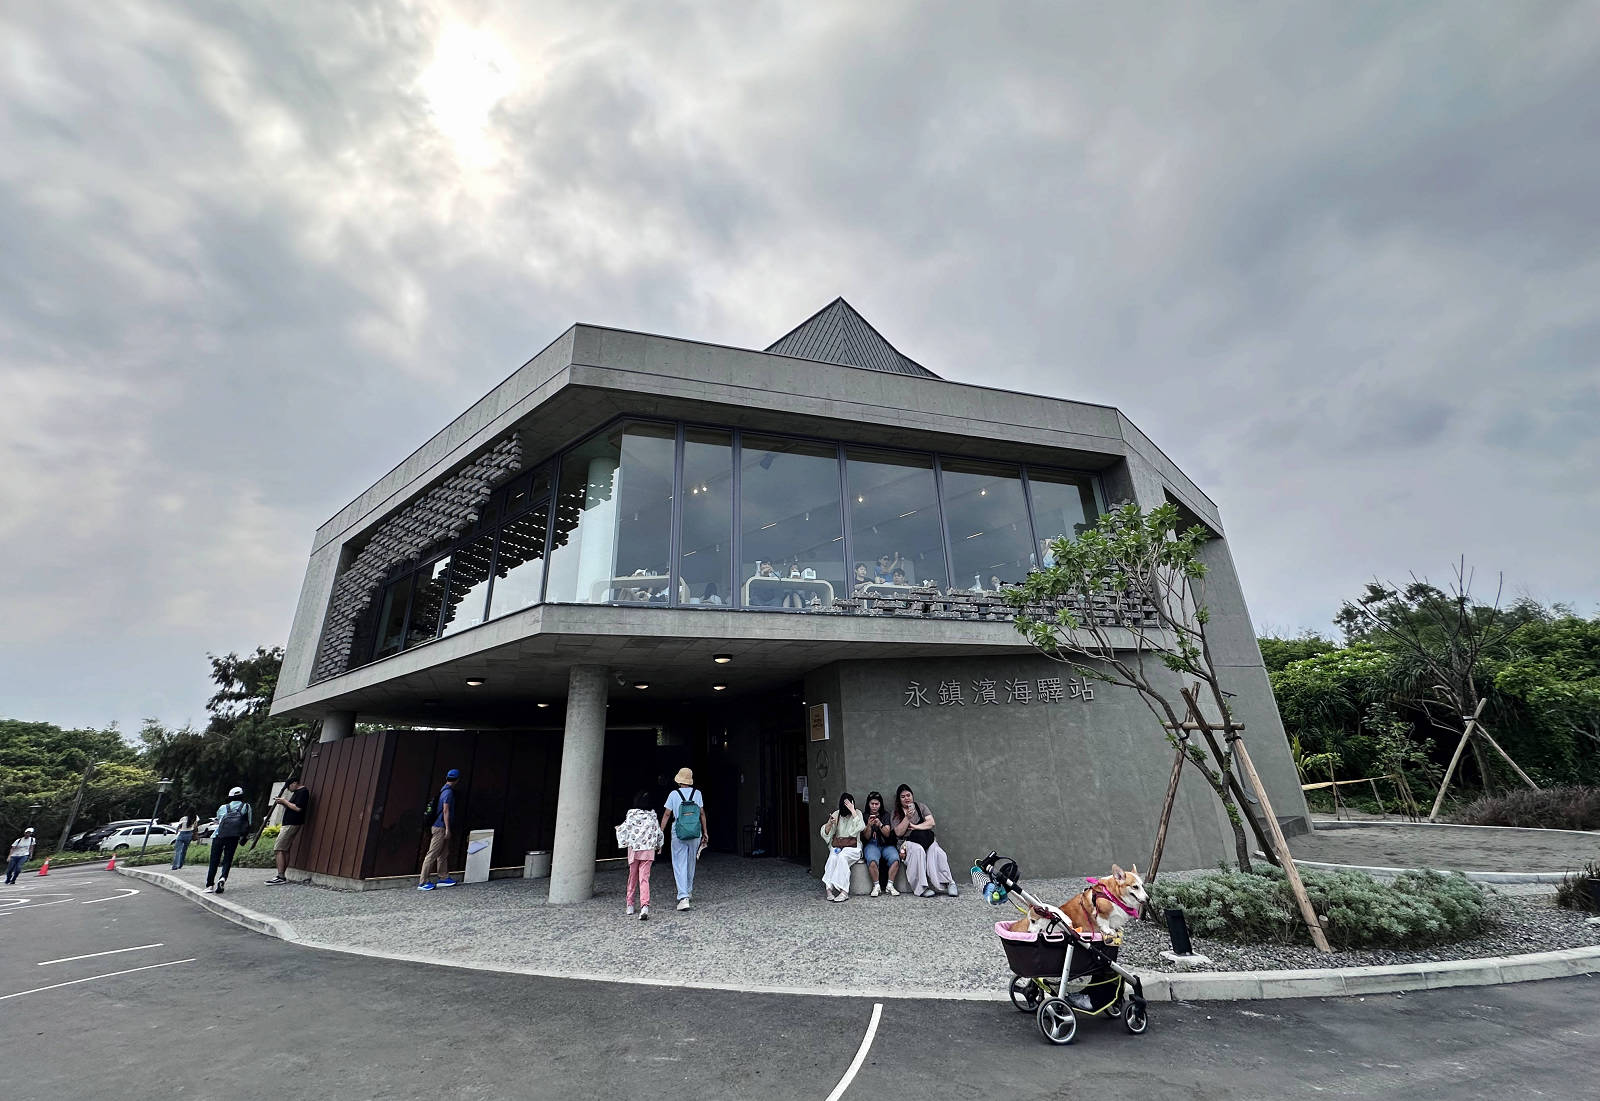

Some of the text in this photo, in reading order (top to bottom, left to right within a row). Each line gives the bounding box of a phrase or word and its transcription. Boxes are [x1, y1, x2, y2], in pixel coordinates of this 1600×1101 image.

[903, 676, 1095, 708] 永鎮濱海驛站
